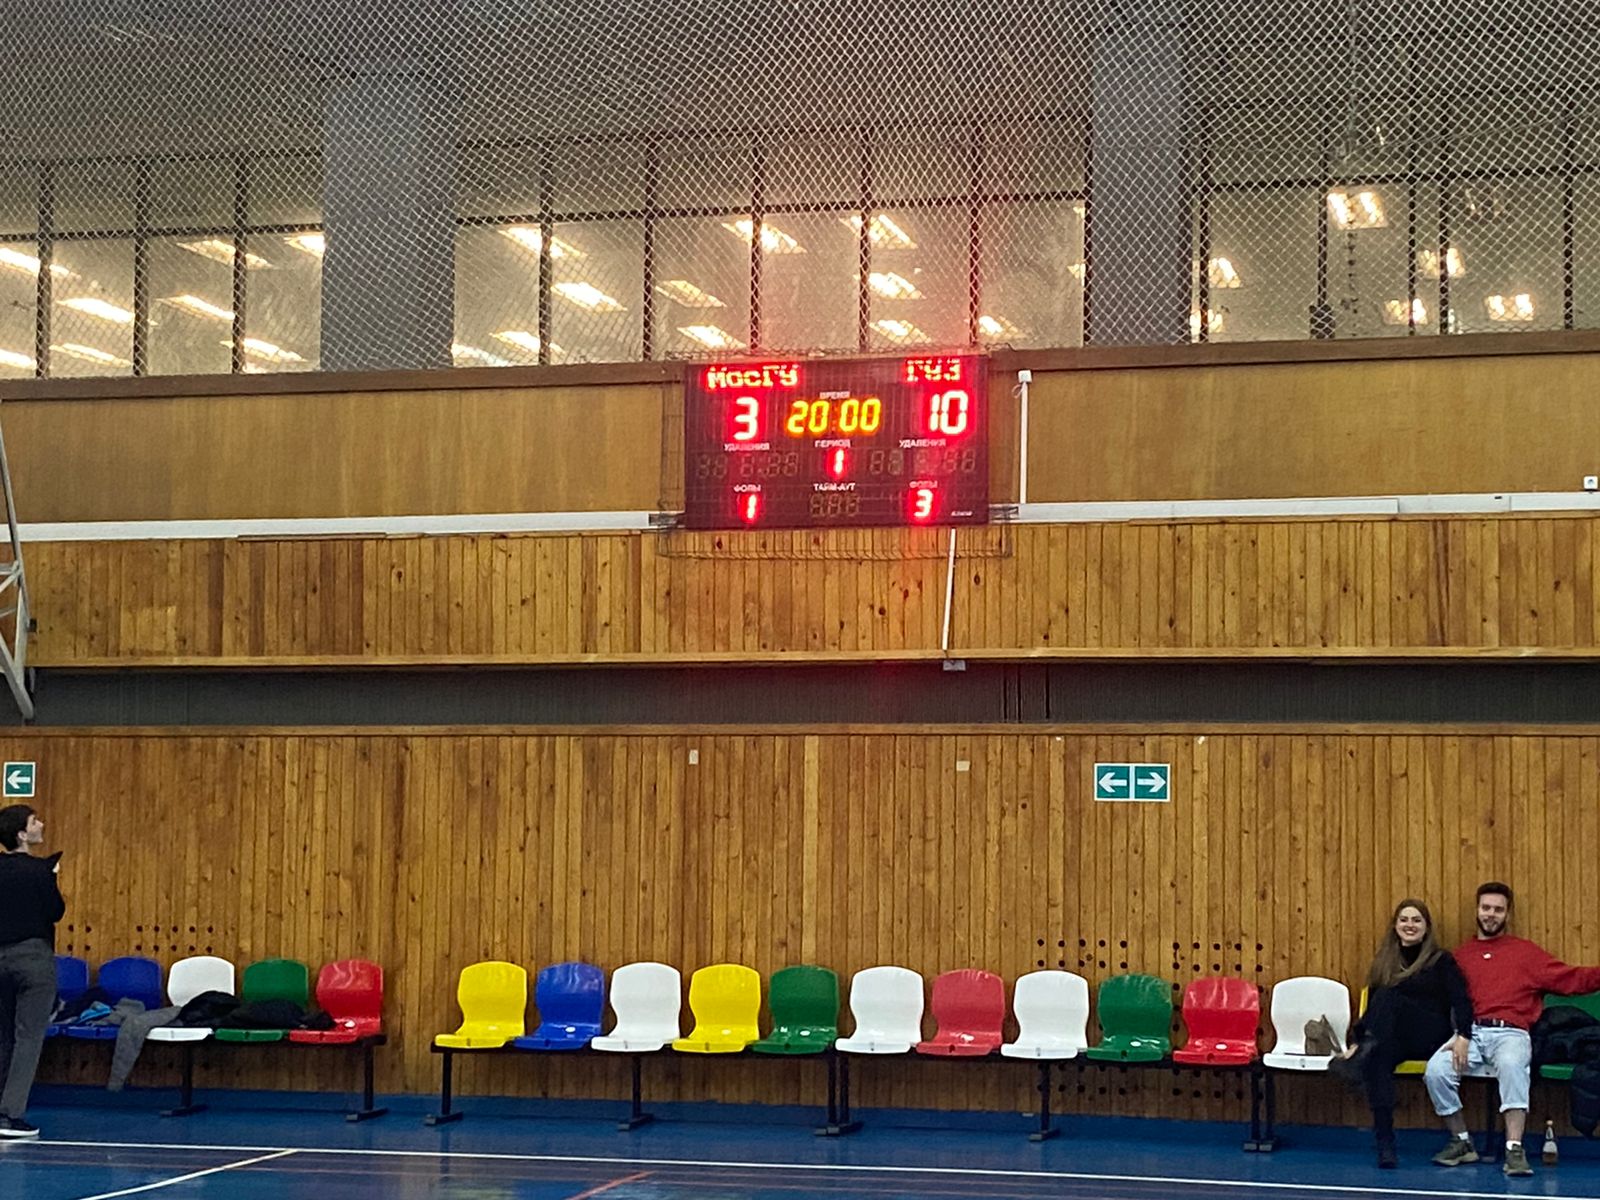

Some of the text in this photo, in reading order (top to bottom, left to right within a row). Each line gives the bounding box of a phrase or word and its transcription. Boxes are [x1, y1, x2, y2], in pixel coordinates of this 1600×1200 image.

[733, 396, 759, 441] 3
[929, 389, 969, 435] 10
[899, 438, 947, 449] УДАЛЕНИЯ
[833, 448, 845, 475] 1
[746, 493, 757, 520] 1
[913, 488, 934, 518] 3
